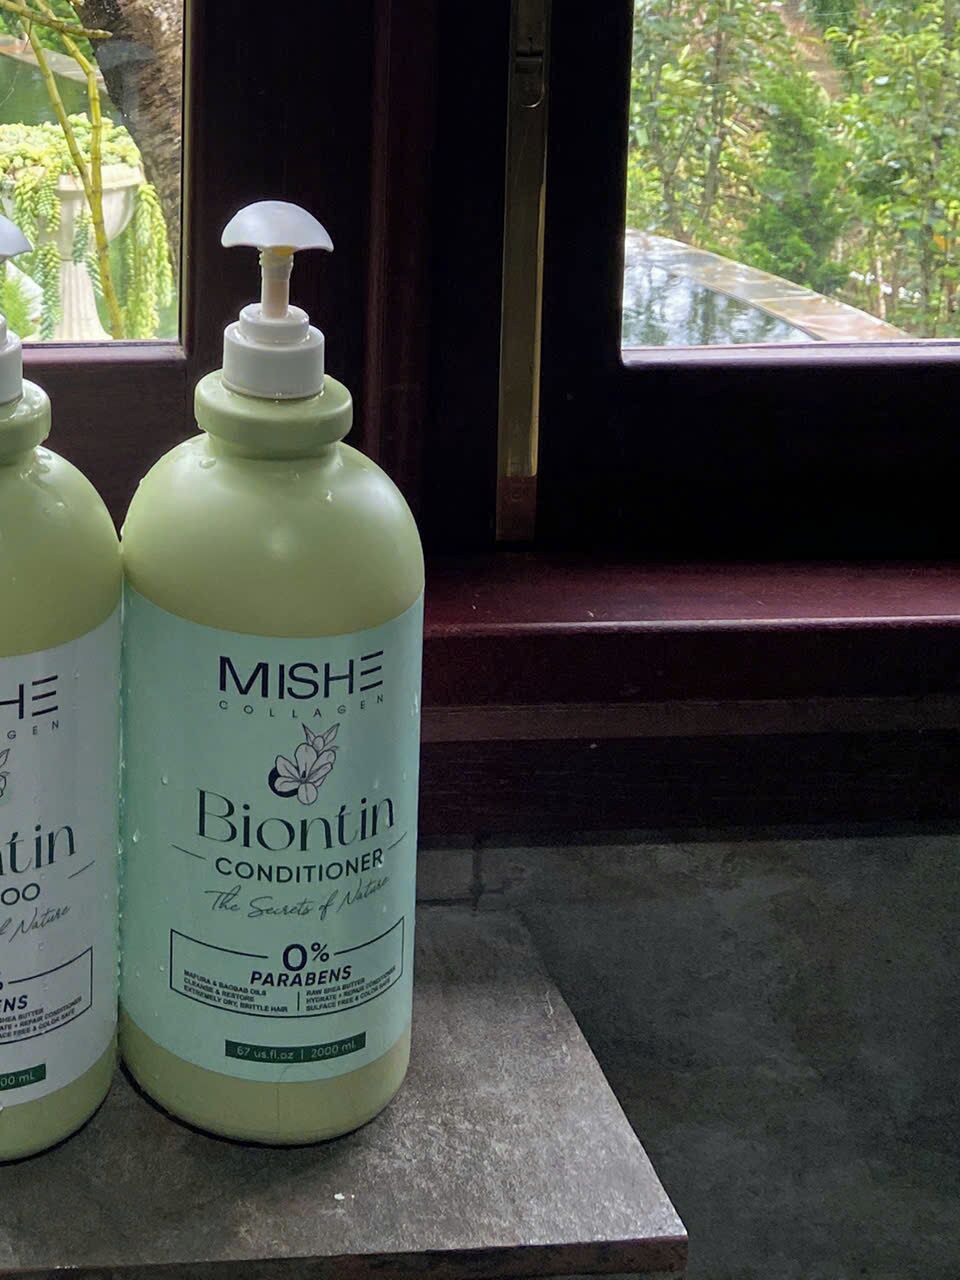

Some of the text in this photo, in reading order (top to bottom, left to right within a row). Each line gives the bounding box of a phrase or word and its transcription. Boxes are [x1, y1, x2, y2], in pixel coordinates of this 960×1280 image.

[219, 650, 384, 700] MISHE
[219, 694, 384, 718] COLLAGEN
[196, 787, 394, 852] Biontin
[215, 848, 383, 883] CONDITIONER
[204, 876, 390, 921] The Secrets of Nature
[9, 905, 71, 943] Nature
[282, 942, 330, 972] 0%
[250, 965, 352, 987] PARABENS
[184, 984, 222, 1003] EXTREMELY
[240, 1002, 270, 1012] BRITTLE
[270, 1005, 288, 1013] HAIR
[221, 990, 255, 1002] RESTORE
[306, 989, 323, 997] RAW
[306, 995, 337, 1004] HYDRATE
[18, 1007, 44, 1020] BUTTER
[19, 1017, 43, 1028] REPAIR
[236, 1046, 251, 1056] 67
[311, 1044, 339, 1058] 2000
